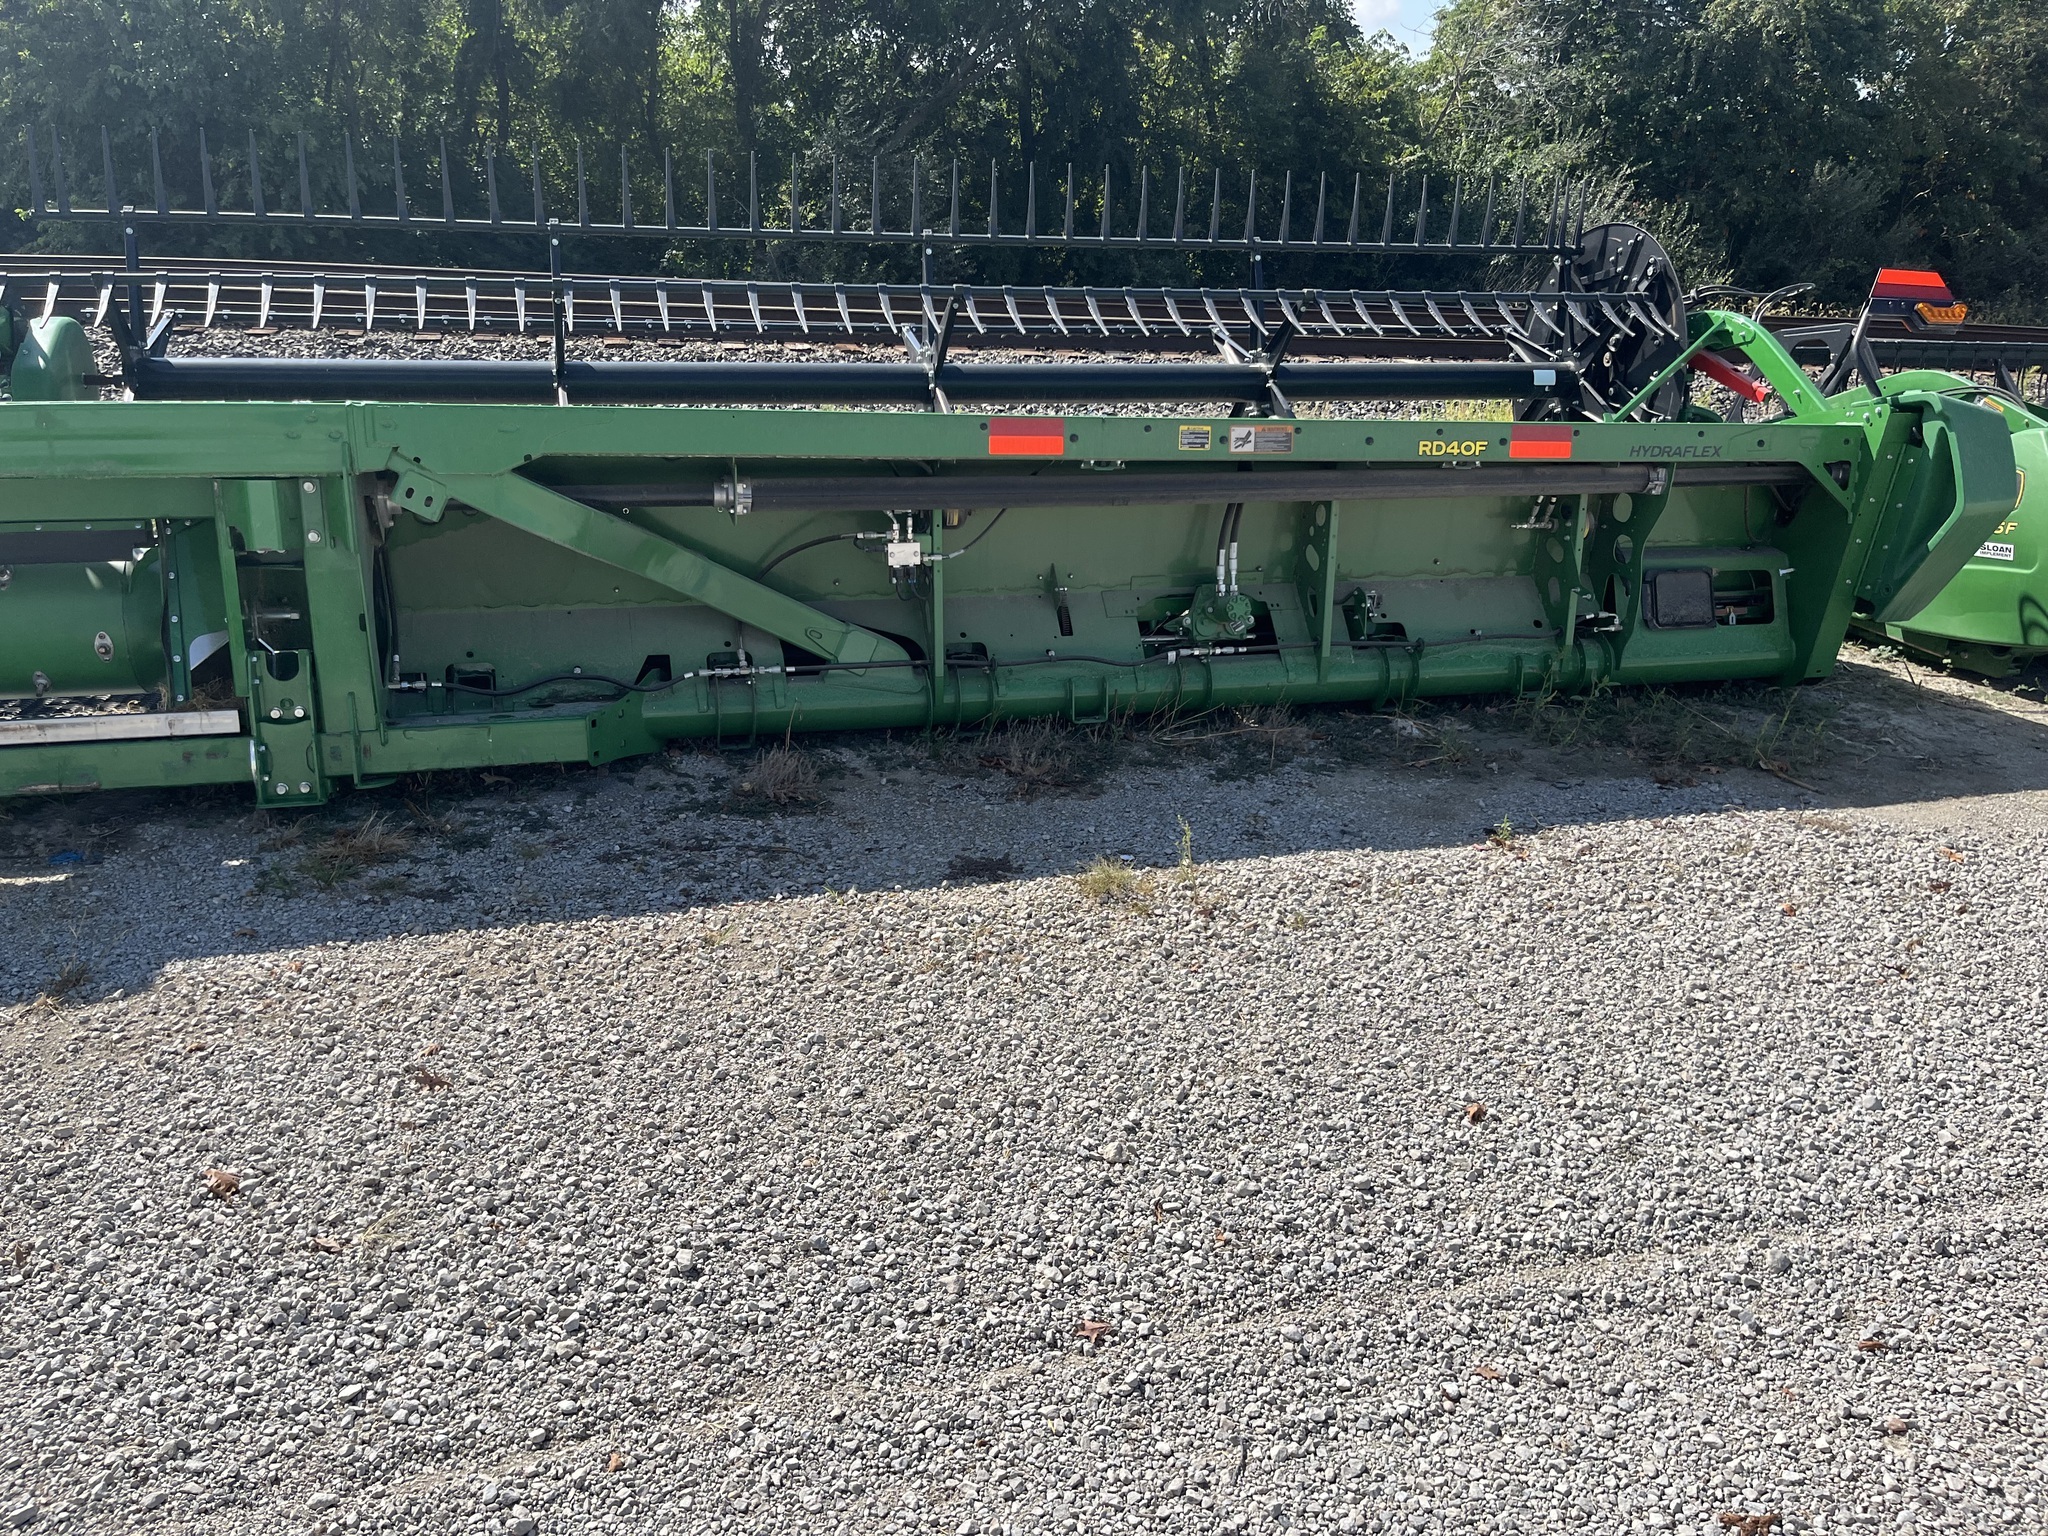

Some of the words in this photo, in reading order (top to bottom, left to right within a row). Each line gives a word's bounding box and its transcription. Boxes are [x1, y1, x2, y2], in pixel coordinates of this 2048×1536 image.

[1418, 440, 1489, 456] RD40F
[1629, 445, 1723, 458] HYDRAFLEX
[1980, 544, 2012, 554] SLOAN
[1980, 550, 2011, 558] IMPLEMENT
